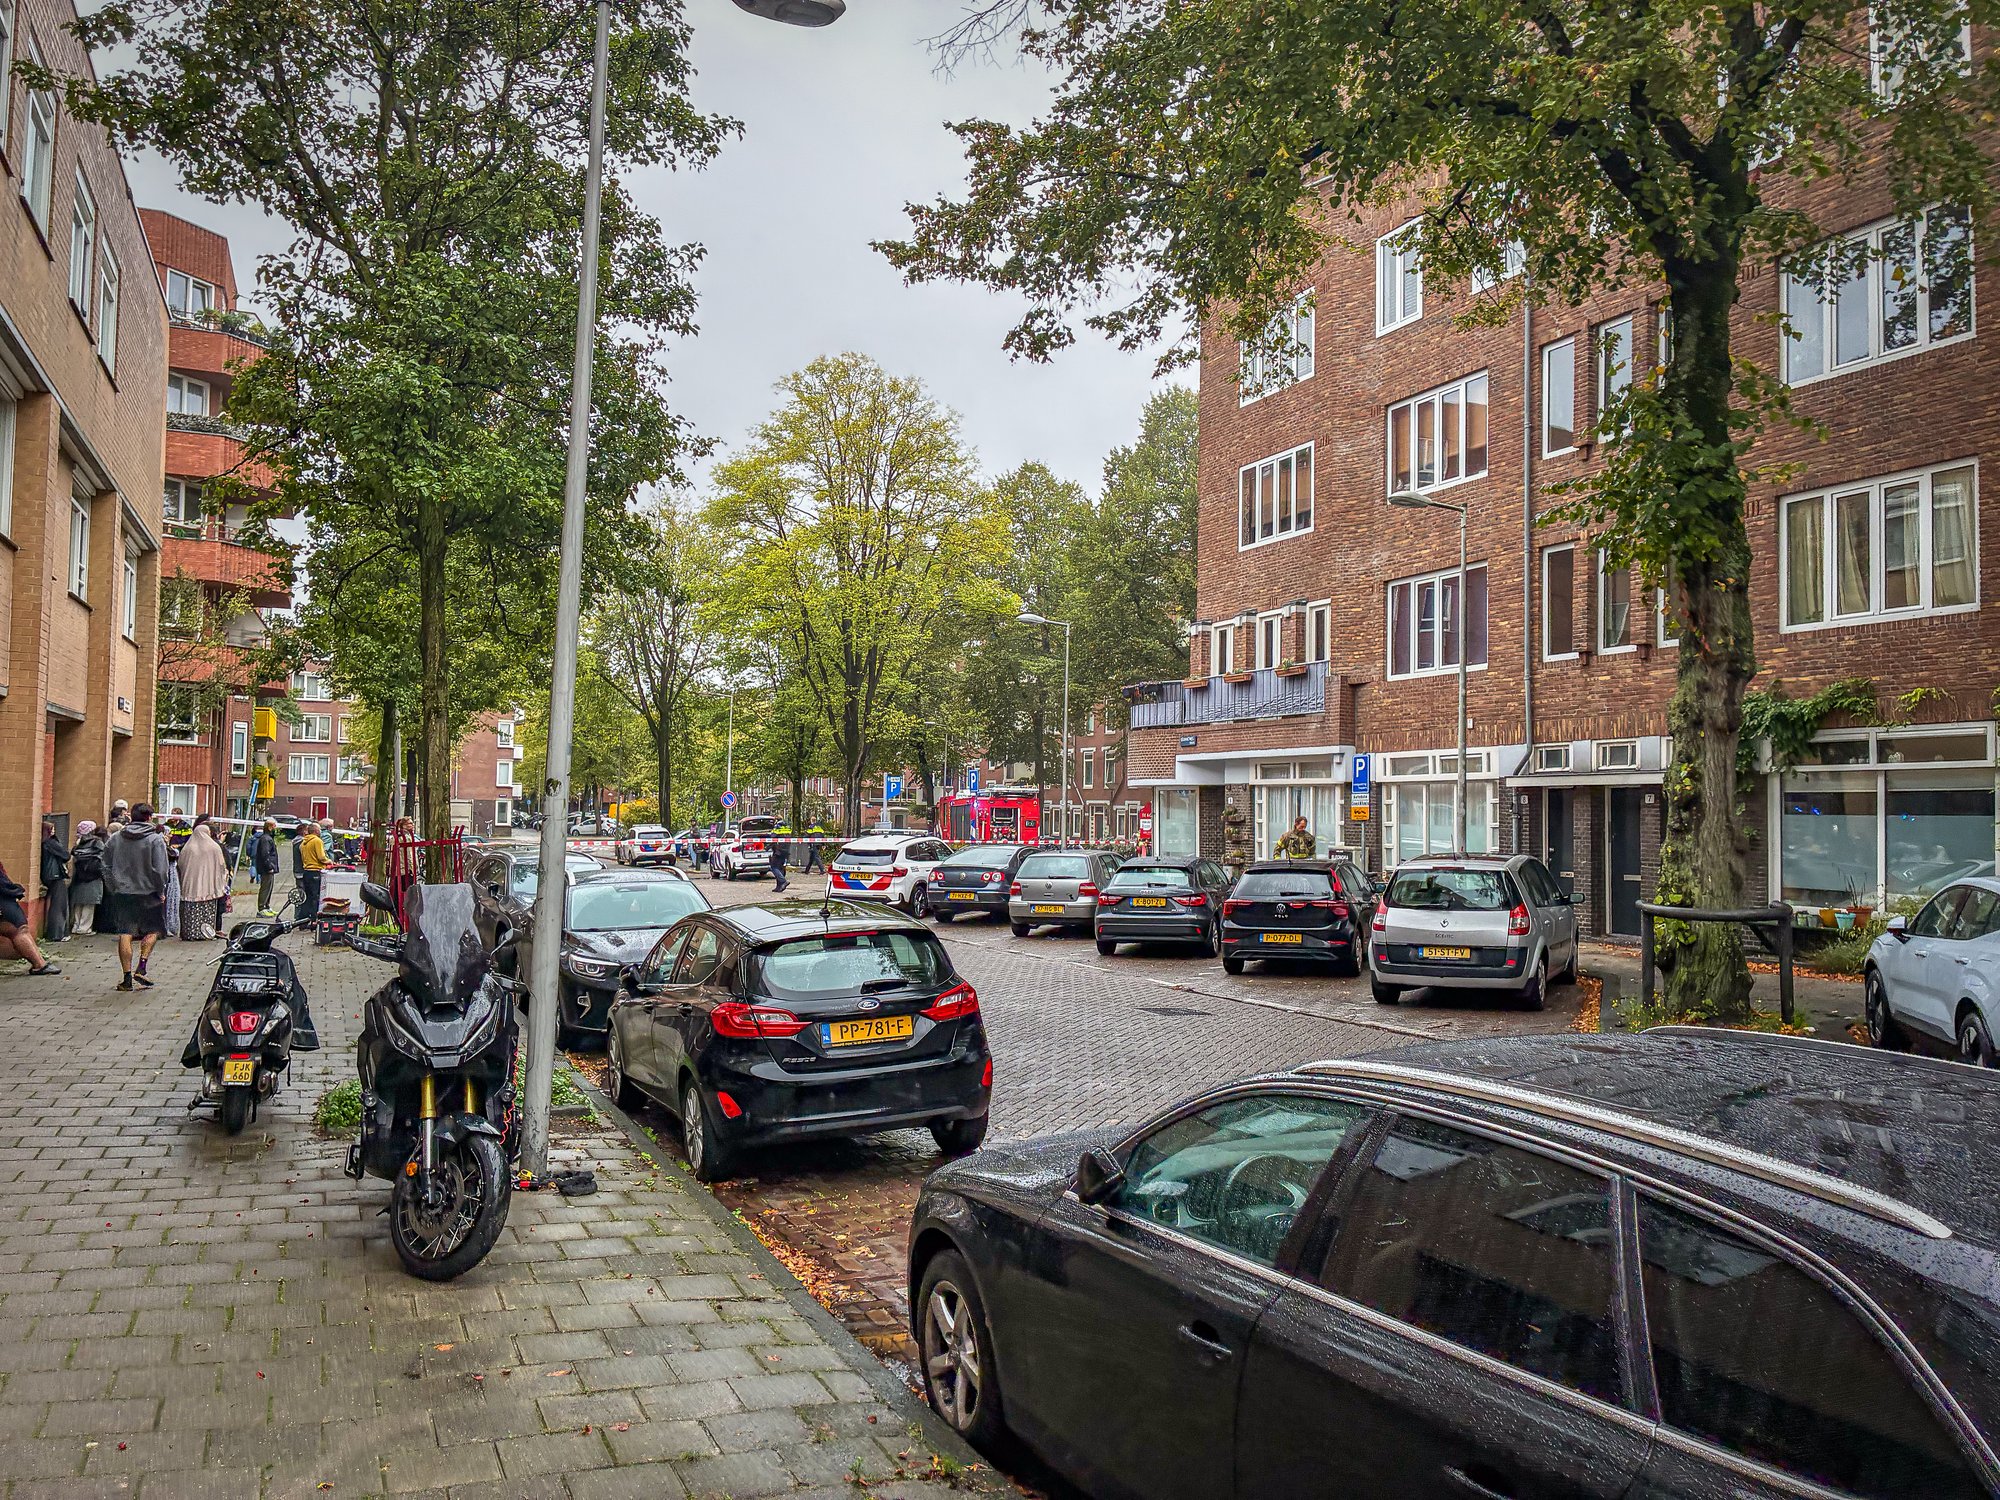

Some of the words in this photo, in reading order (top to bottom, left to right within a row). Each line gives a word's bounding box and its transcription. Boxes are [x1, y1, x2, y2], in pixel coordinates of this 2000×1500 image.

[1356, 758, 1366, 778] P
[971, 773, 977, 786] P
[891, 783, 897, 793] P
[1266, 934, 1299, 942] P-077-DL
[1428, 948, 1465, 956] 51-ST-FV
[840, 1019, 905, 1040] PP-781-F
[233, 1063, 251, 1071] FJK
[232, 1072, 250, 1081] 66D
